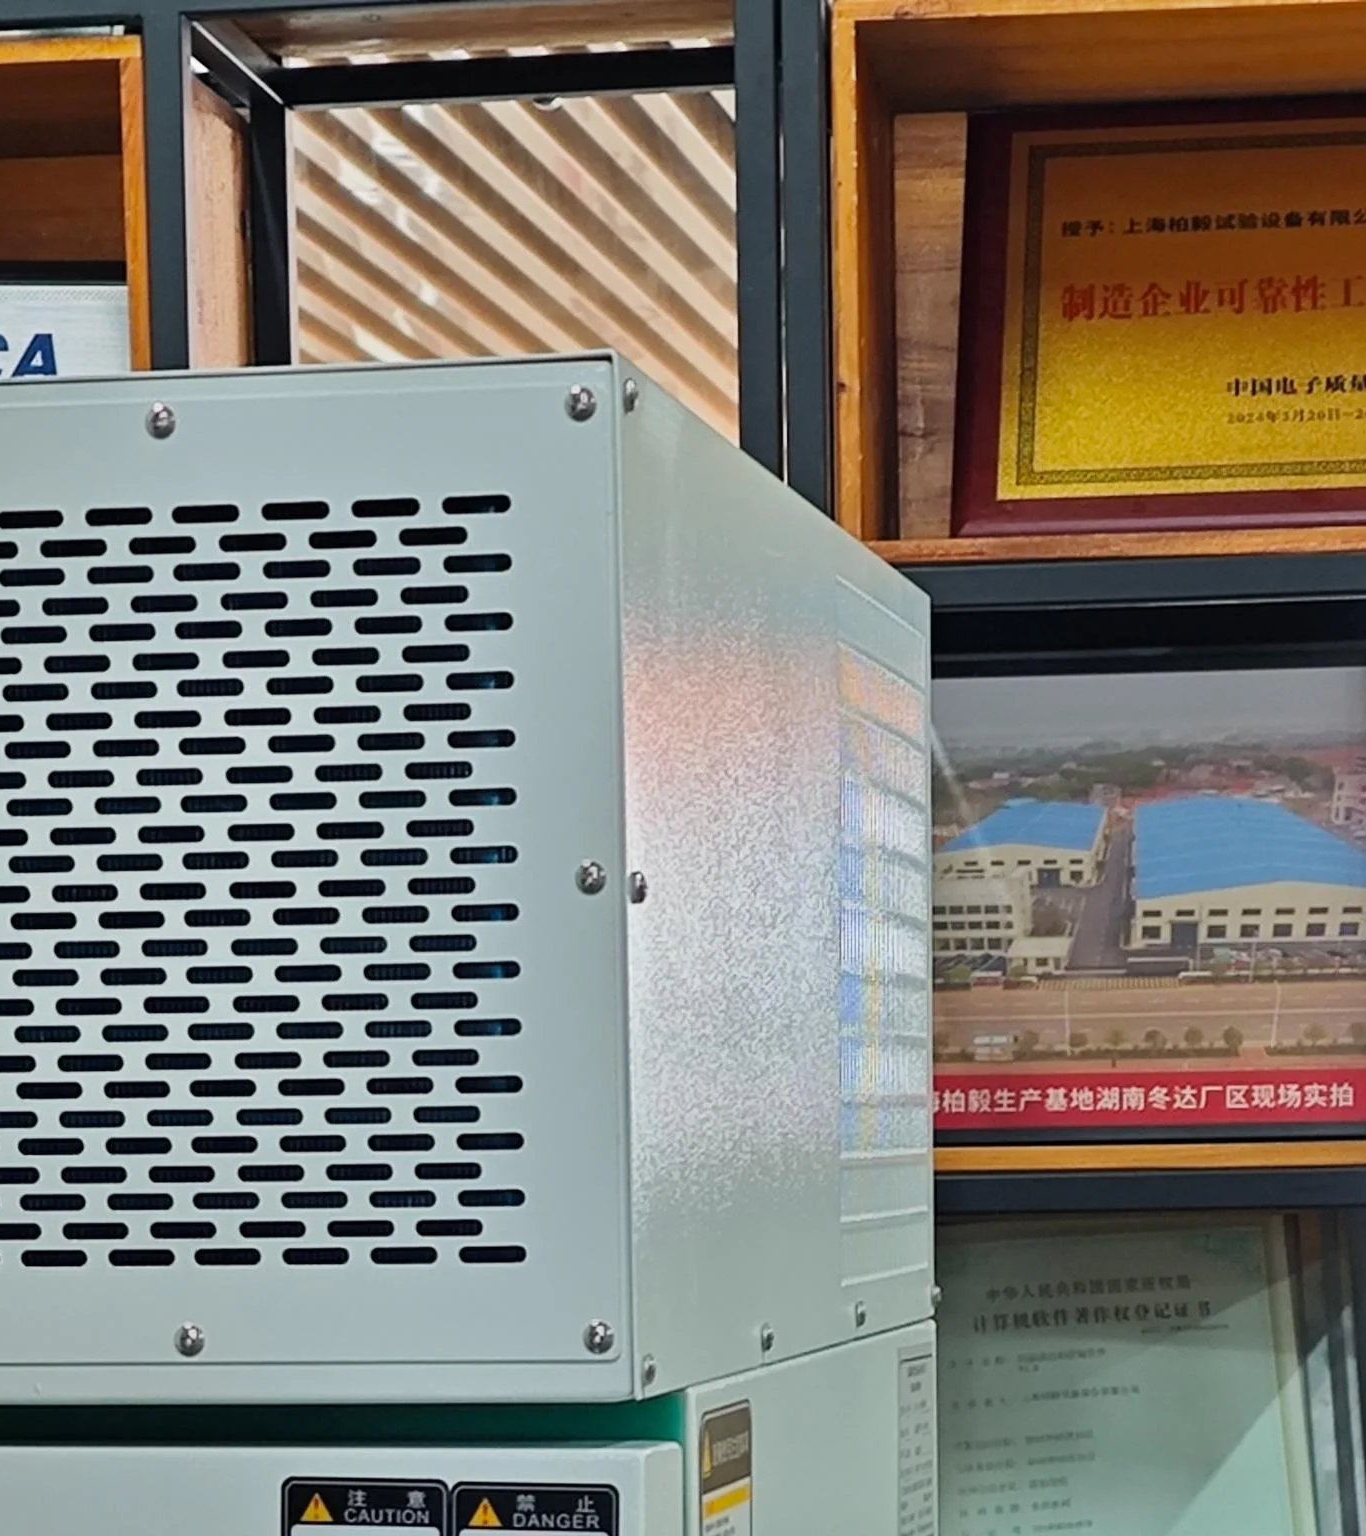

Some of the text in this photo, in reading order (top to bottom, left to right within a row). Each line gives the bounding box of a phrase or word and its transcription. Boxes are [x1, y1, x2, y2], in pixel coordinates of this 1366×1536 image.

[973, 1300, 1212, 1334] 计算机软件著作权登记证书
[347, 1489, 427, 1508] 注意
[516, 1494, 596, 1513] 禁止
[343, 1507, 431, 1525] CAUTION
[512, 1513, 601, 1530] DANGER
